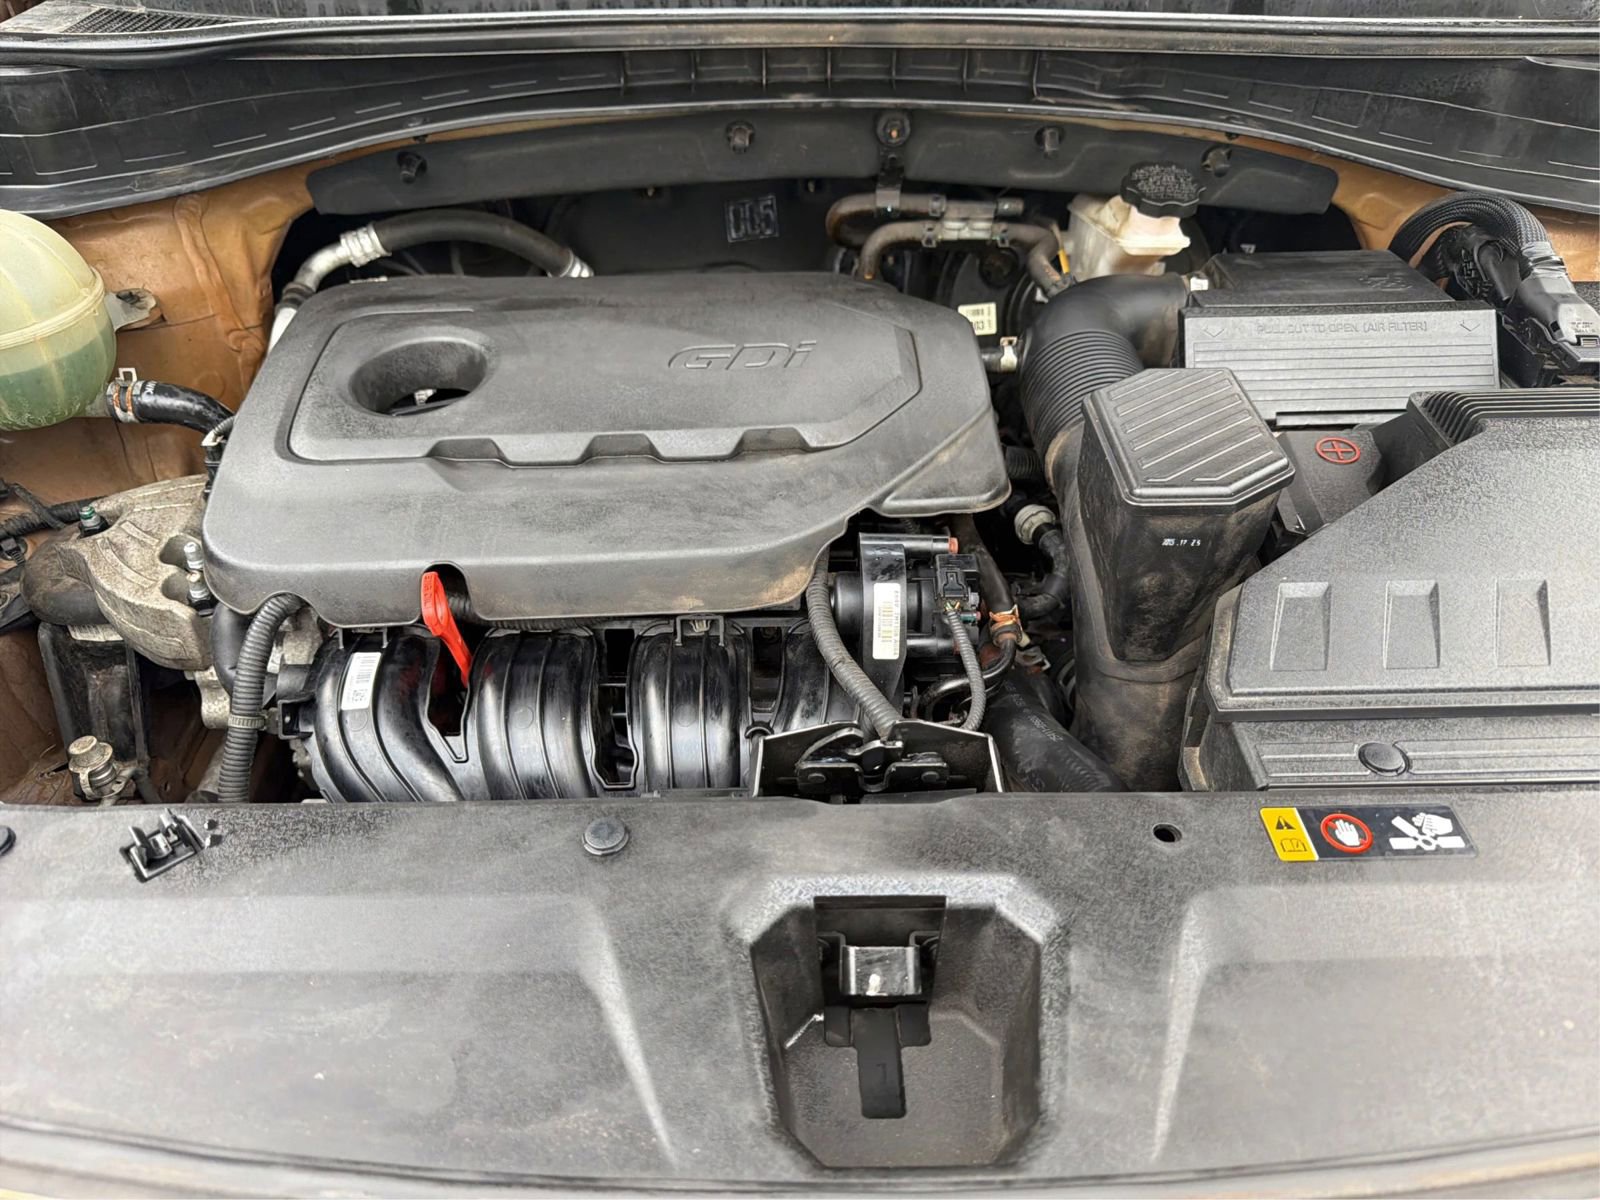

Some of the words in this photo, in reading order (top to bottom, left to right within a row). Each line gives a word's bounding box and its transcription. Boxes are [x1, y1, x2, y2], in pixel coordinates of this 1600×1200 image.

[1256, 324, 1284, 334] PULL
[1288, 323, 1310, 334] OUT
[1311, 323, 1325, 333] TO
[1328, 322, 1359, 333] OPEN
[668, 340, 817, 370] GDi
